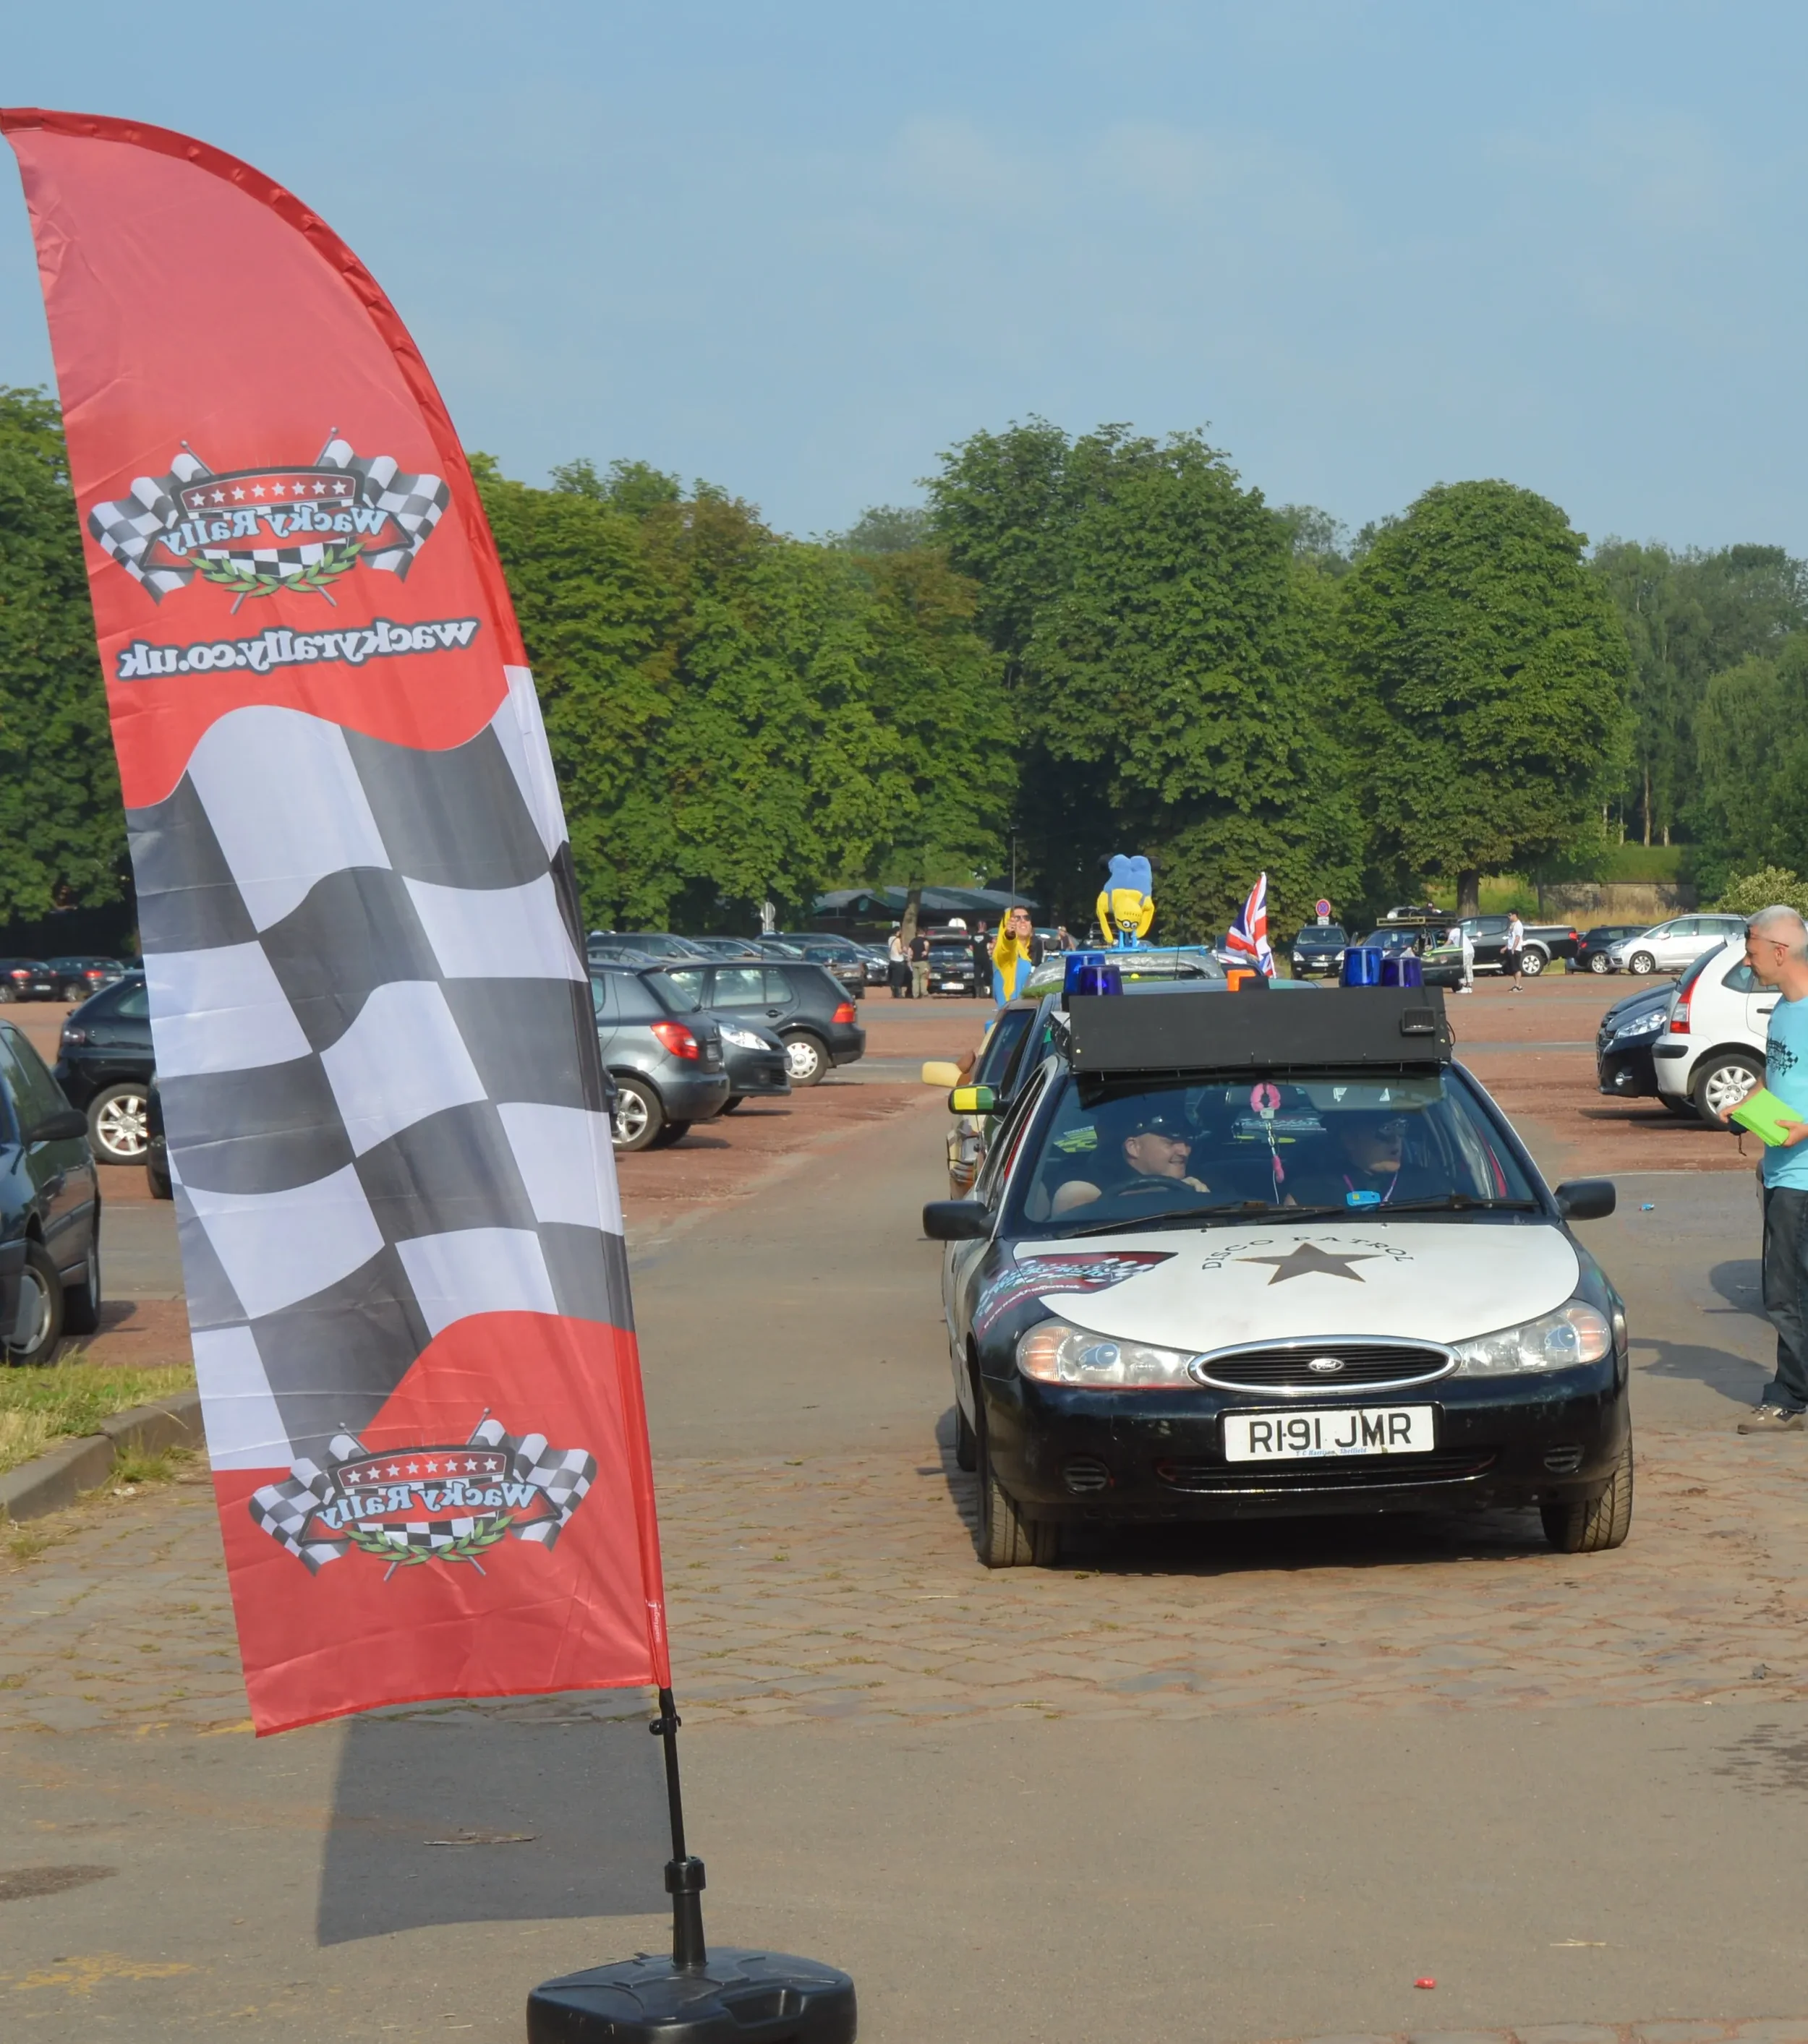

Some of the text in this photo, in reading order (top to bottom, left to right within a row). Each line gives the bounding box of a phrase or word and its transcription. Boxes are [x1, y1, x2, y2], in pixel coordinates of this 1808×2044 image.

[1202, 1236, 1415, 1270] DISCO PATROL
[1249, 1413, 1412, 1453] R191 JMR
